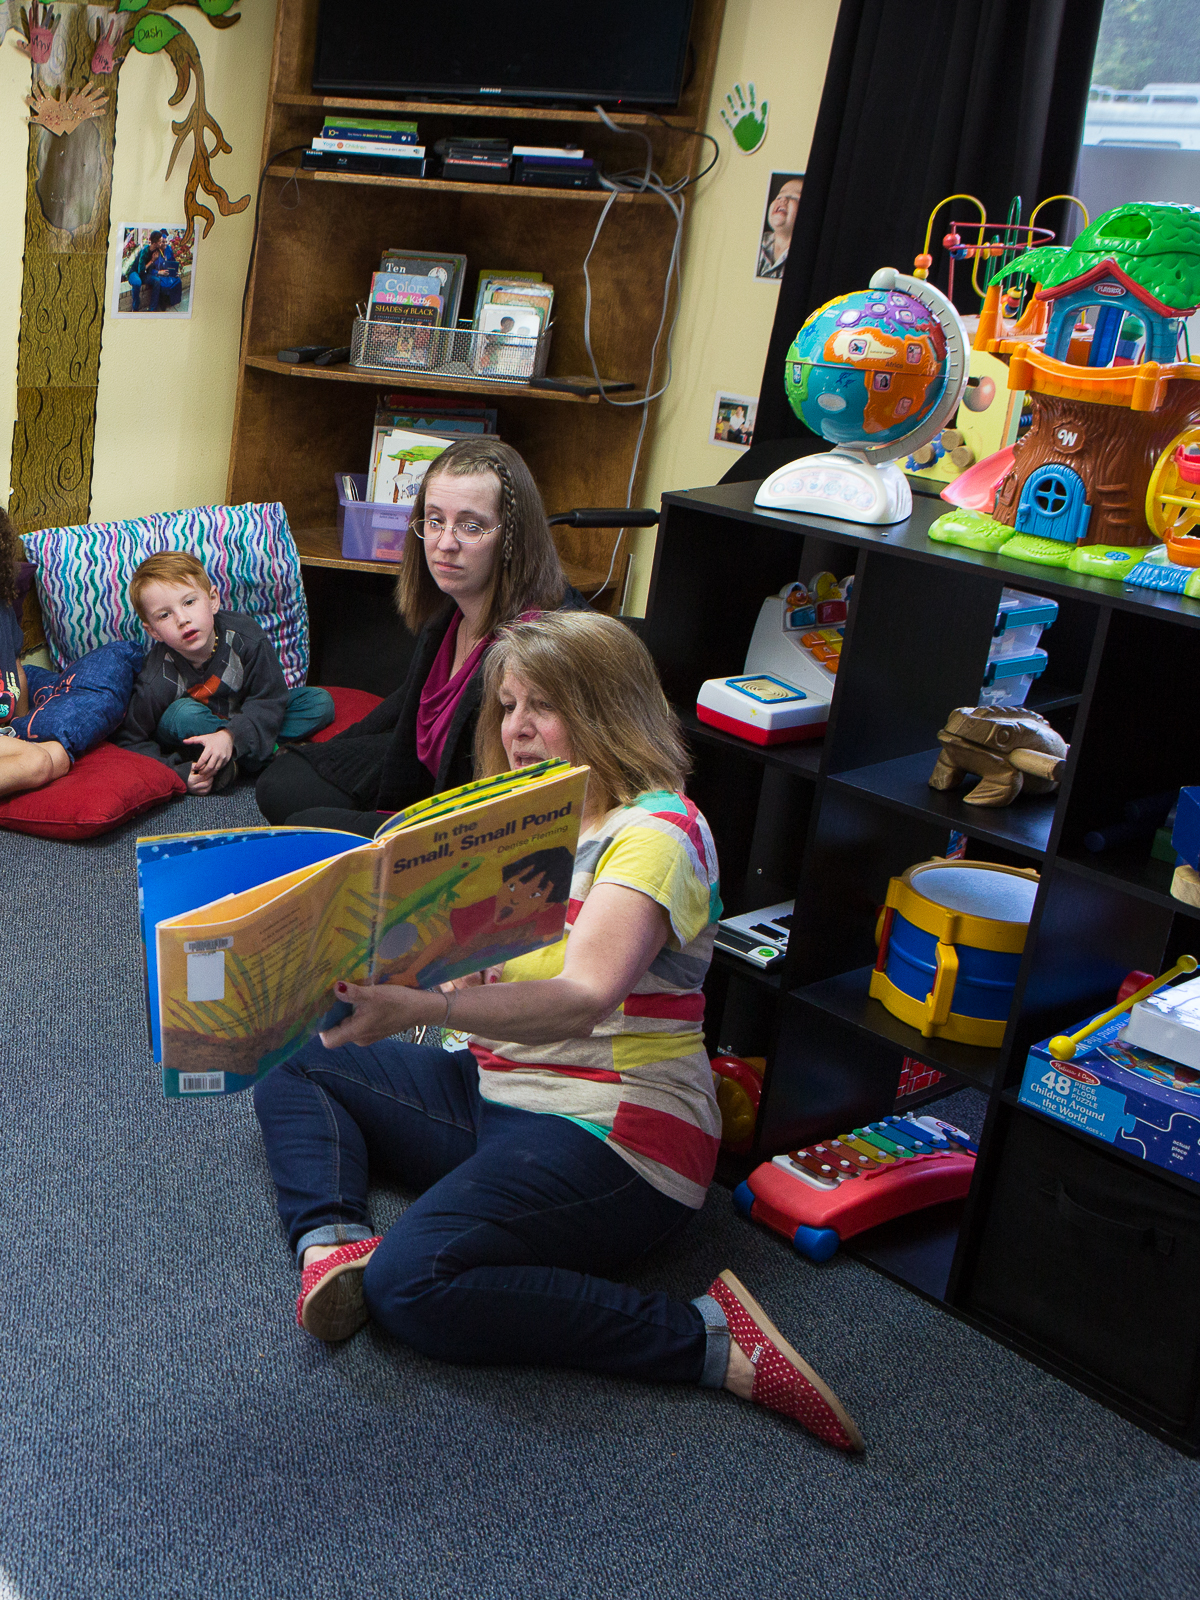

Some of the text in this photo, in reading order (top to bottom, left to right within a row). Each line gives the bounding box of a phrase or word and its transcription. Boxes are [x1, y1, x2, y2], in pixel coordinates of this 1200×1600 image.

[138, 26, 162, 42] Dash
[386, 262, 406, 274] Ten
[385, 279, 428, 294] Colors
[386, 294, 432, 306] Hello Kitty
[375, 305, 402, 313] SHADES
[1058, 429, 1078, 446] W
[393, 801, 572, 874] Small, Small Pond
[434, 821, 478, 843] In the
[497, 825, 568, 854] Denise Fleming
[1041, 1071, 1071, 1095] 48
[1074, 1082, 1096, 1094] PIECE
[1030, 1083, 1105, 1121] Children Around
[1071, 1094, 1098, 1109] PUZZLE
[1073, 1088, 1097, 1102] FLOOR
[1027, 1100, 1041, 1108] inches
[1086, 1126, 1099, 1134] AGES
[1042, 1099, 1056, 1110] the
[1060, 1105, 1087, 1124] World
[1172, 1146, 1187, 1155] piece
[1173, 1140, 1190, 1150] actual
